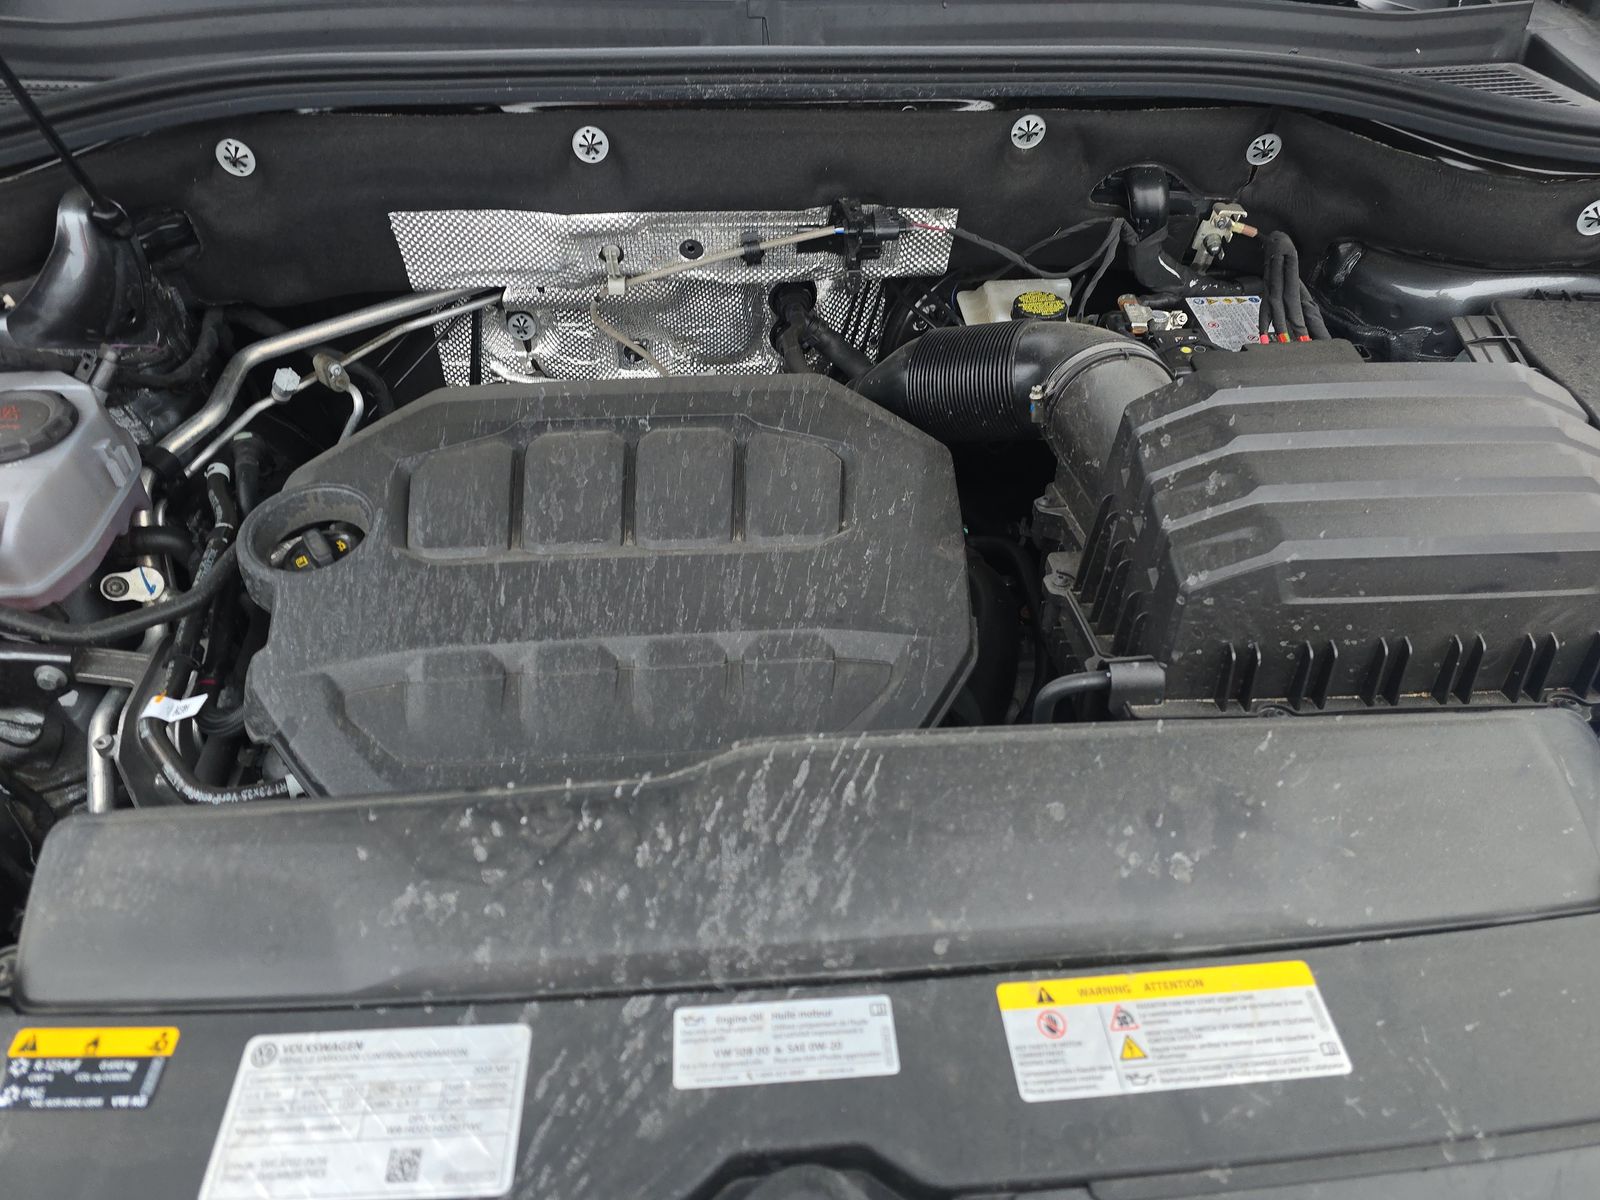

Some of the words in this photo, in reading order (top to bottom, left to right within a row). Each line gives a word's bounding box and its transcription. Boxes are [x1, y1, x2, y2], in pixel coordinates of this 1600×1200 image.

[1076, 984, 1133, 998] WARNING
[1143, 978, 1205, 993] ATTENTION
[715, 1013, 748, 1025] Engine
[798, 1008, 833, 1018] moteur
[282, 1039, 365, 1055] VOLKSWAGEN
[713, 1047, 732, 1058] VW
